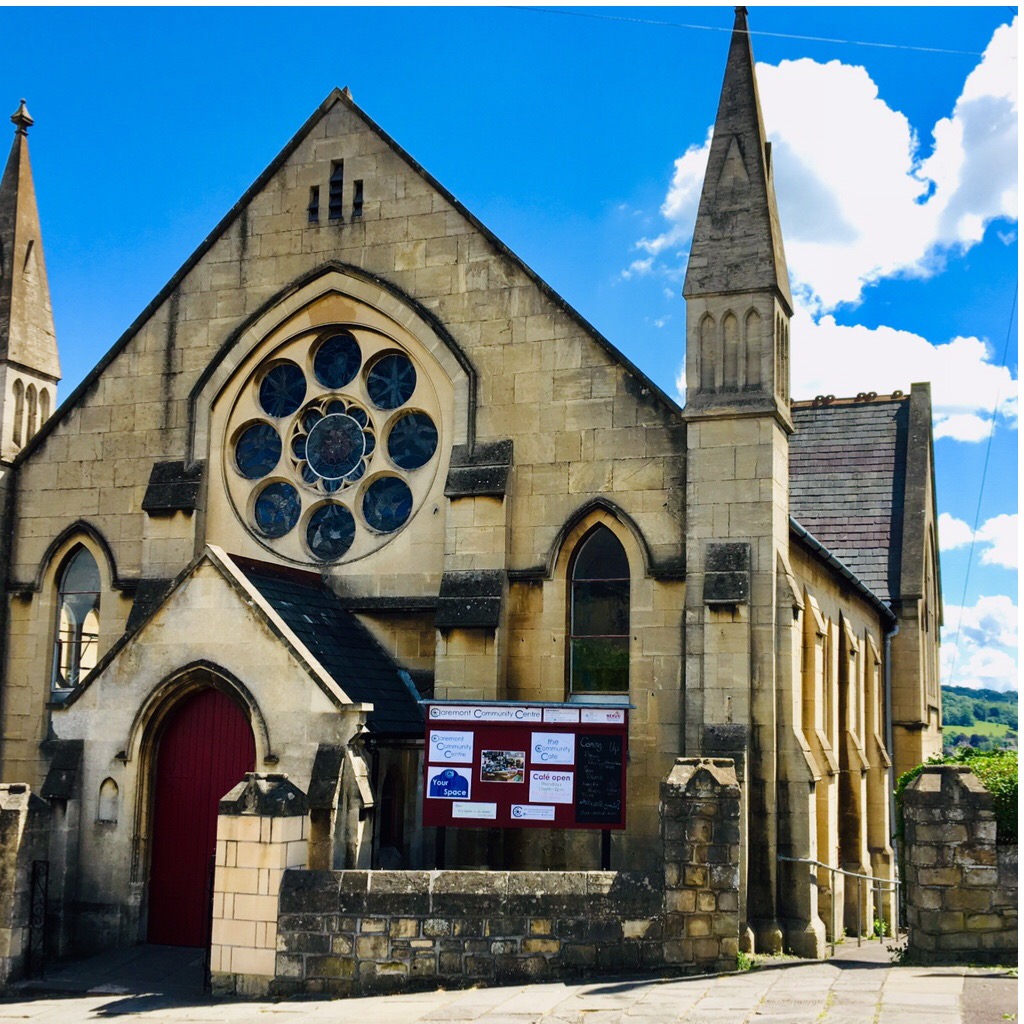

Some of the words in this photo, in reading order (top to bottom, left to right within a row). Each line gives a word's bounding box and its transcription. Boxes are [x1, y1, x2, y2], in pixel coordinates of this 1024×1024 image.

[430, 707, 471, 718] Claremont
[474, 708, 513, 719] Community
[515, 709, 541, 719] Centre
[436, 742, 472, 750] Community
[535, 744, 571, 753] Community
[444, 750, 467, 758] Centre
[532, 772, 550, 780] Café
[443, 788, 467, 796] Space
